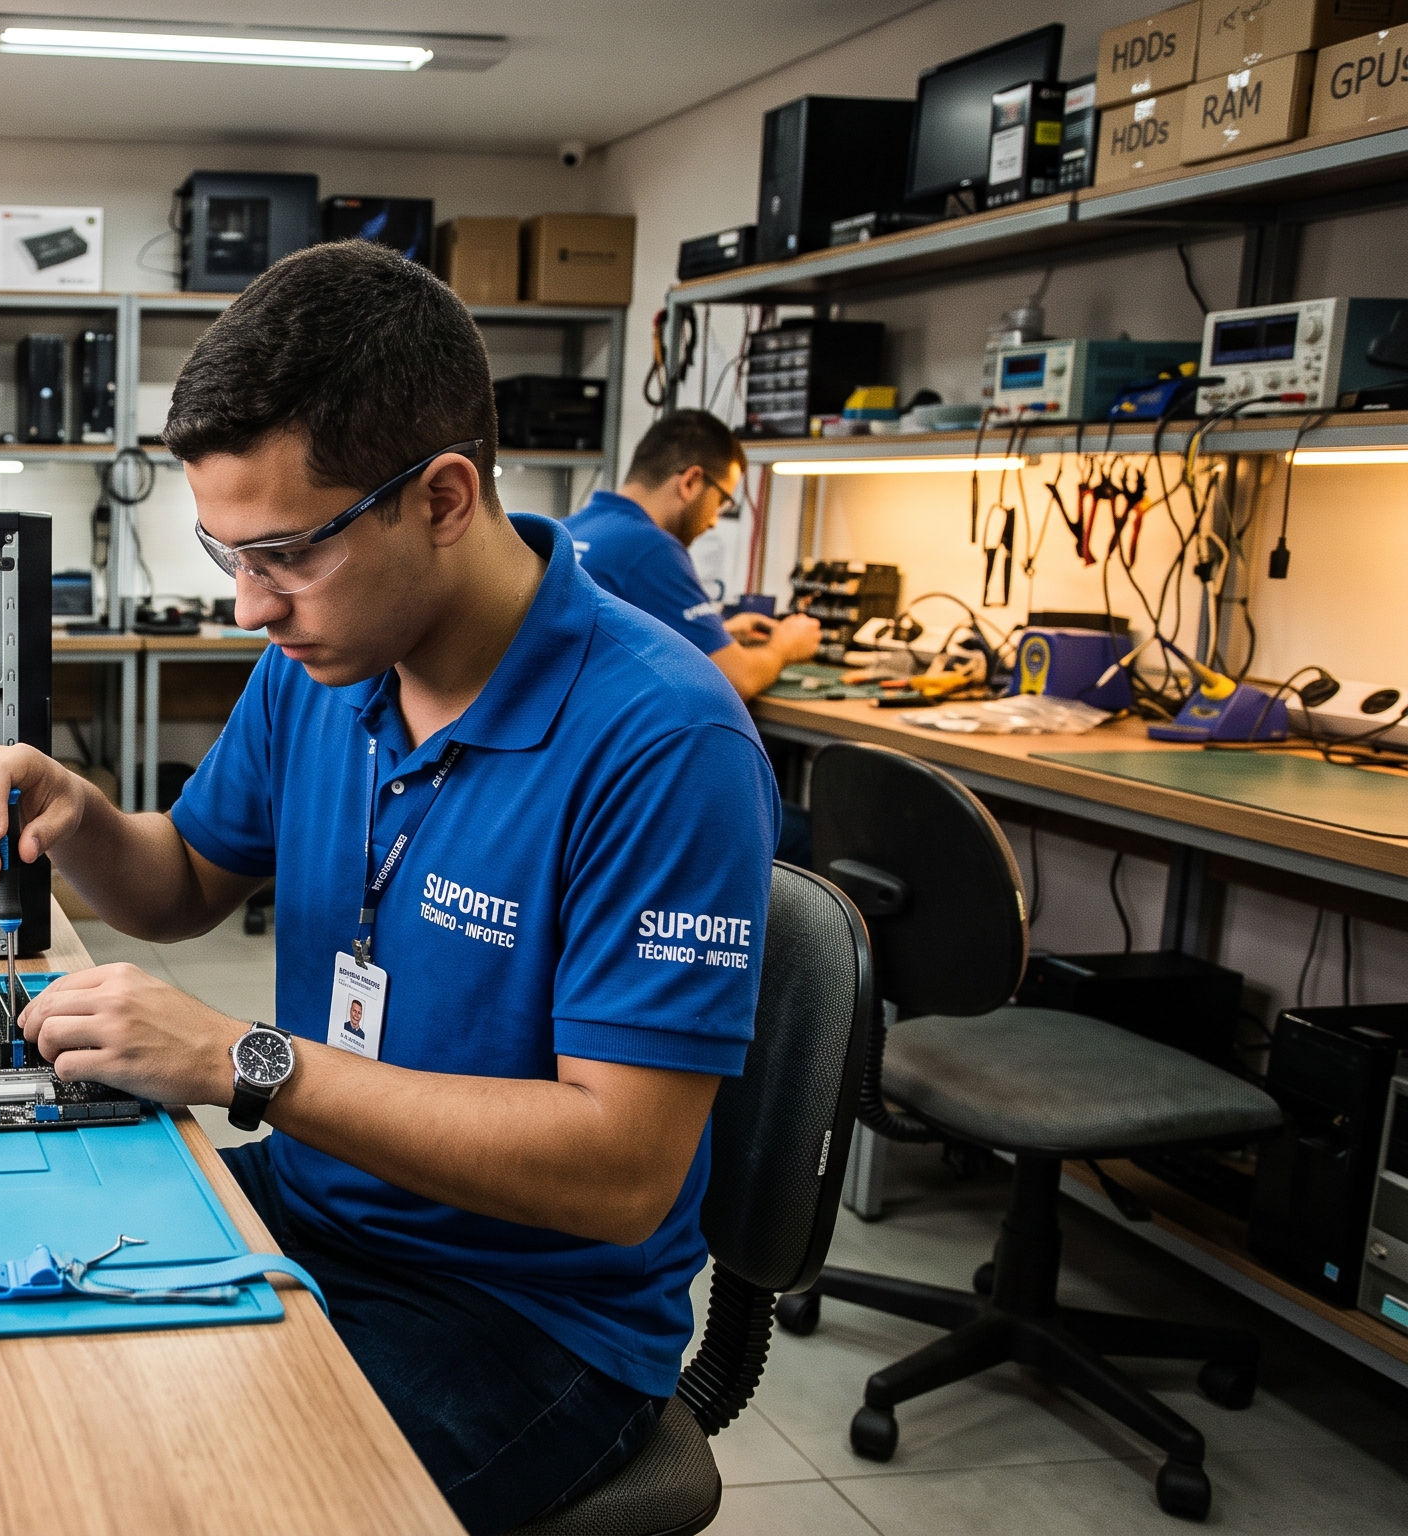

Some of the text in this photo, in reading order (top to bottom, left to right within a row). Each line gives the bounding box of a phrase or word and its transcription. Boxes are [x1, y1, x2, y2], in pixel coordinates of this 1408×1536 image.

[1111, 29, 1177, 75] HDDs
[1201, 80, 1263, 130] RAM
[1110, 118, 1170, 156] HDDs
[423, 872, 520, 928] SUPORTE
[420, 901, 457, 931] TÉCNICO
[464, 921, 515, 949] INFOTEC
[638, 910, 752, 947] SUPORTE
[636, 940, 696, 964] TÉCNICO
[705, 950, 749, 970] INFOTEC
